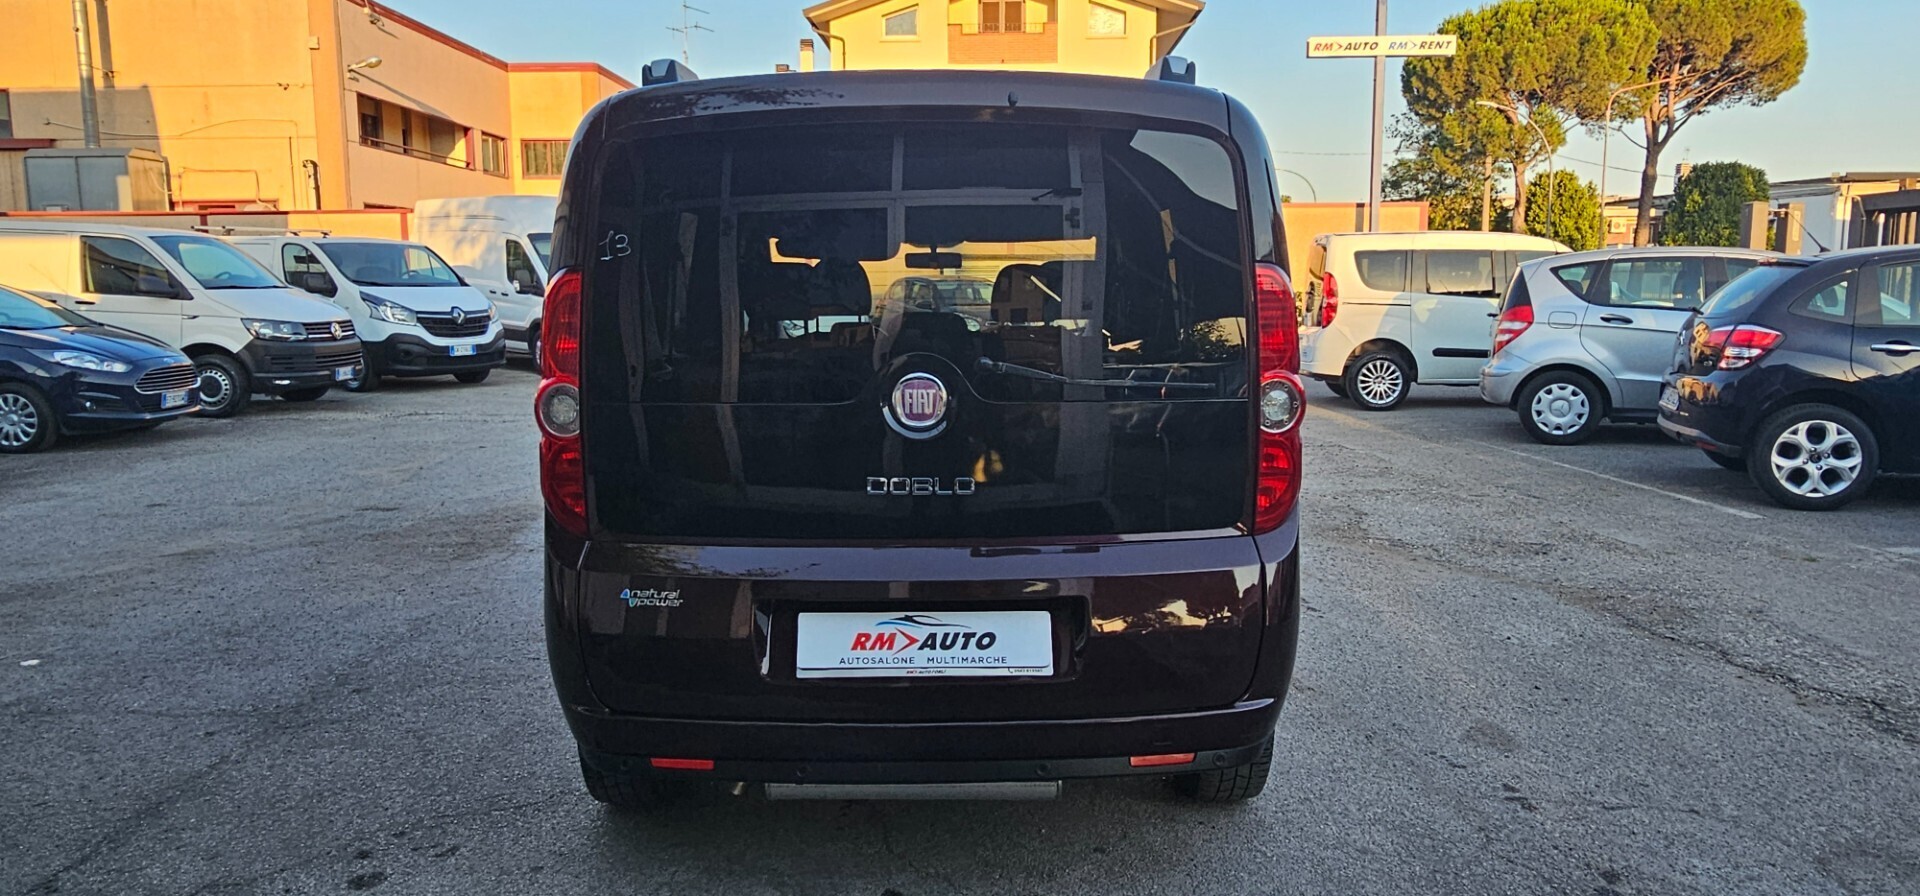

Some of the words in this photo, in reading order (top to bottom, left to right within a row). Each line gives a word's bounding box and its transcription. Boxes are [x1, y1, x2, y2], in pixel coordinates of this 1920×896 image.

[1313, 41, 1334, 52] RM
[1344, 41, 1379, 51] AUTO
[1388, 41, 1408, 50] RM
[1418, 40, 1453, 50] RENT
[598, 230, 632, 260] 13
[904, 388, 937, 414] FIAT
[866, 476, 976, 495] DOBLO
[630, 588, 681, 599] natural
[636, 598, 684, 608] power
[851, 632, 897, 651] RM
[917, 631, 997, 651] AUTO
[839, 656, 915, 665] AUTOSALONE
[927, 656, 1008, 665] MULTIMARCHE
